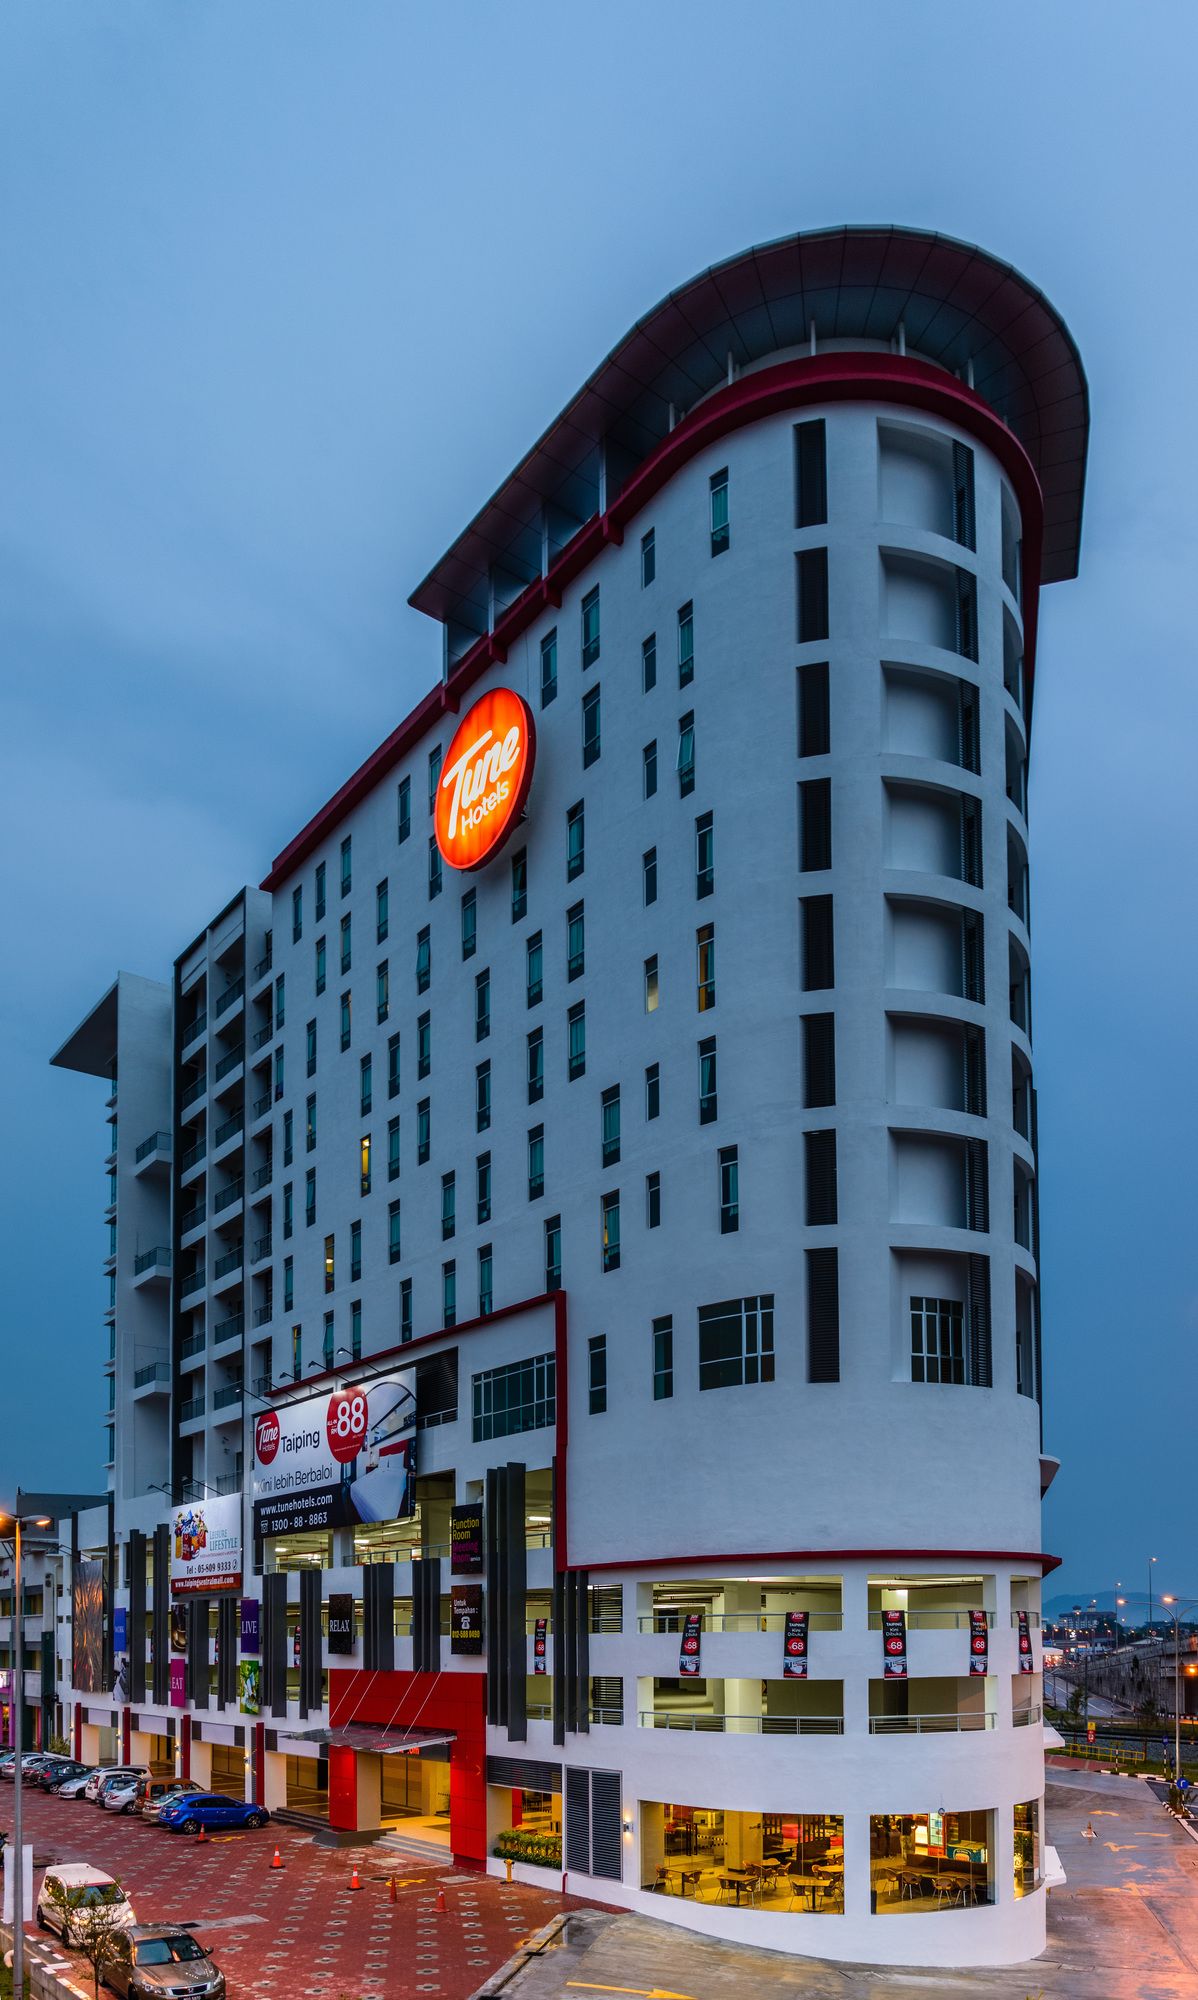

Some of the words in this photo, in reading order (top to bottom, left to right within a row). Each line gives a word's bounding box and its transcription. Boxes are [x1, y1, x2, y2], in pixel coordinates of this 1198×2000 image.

[443, 726, 520, 840] Tune
[461, 780, 509, 836] Hotels
[337, 1396, 365, 1437] 88
[258, 1421, 278, 1451] Tune
[281, 1429, 320, 1453] Taiping
[261, 1443, 276, 1452] Hotels
[273, 1472, 295, 1490] lebih
[295, 1463, 333, 1486] Berbaloi
[260, 1494, 333, 1516] www.tunehotels.com
[271, 1518, 288, 1531] 1300
[309, 1512, 328, 1526] 8863
[452, 1517, 480, 1530] Function
[453, 1529, 471, 1541] Room
[210, 1537, 238, 1551] LIFESTYLE
[241, 1620, 258, 1634] LIVE
[329, 1620, 350, 1632] RELAX
[687, 1641, 698, 1650] 68
[791, 1642, 804, 1650] 68
[890, 1641, 903, 1650] 68
[975, 1640, 985, 1649] 68
[171, 1677, 184, 1689] EAT
